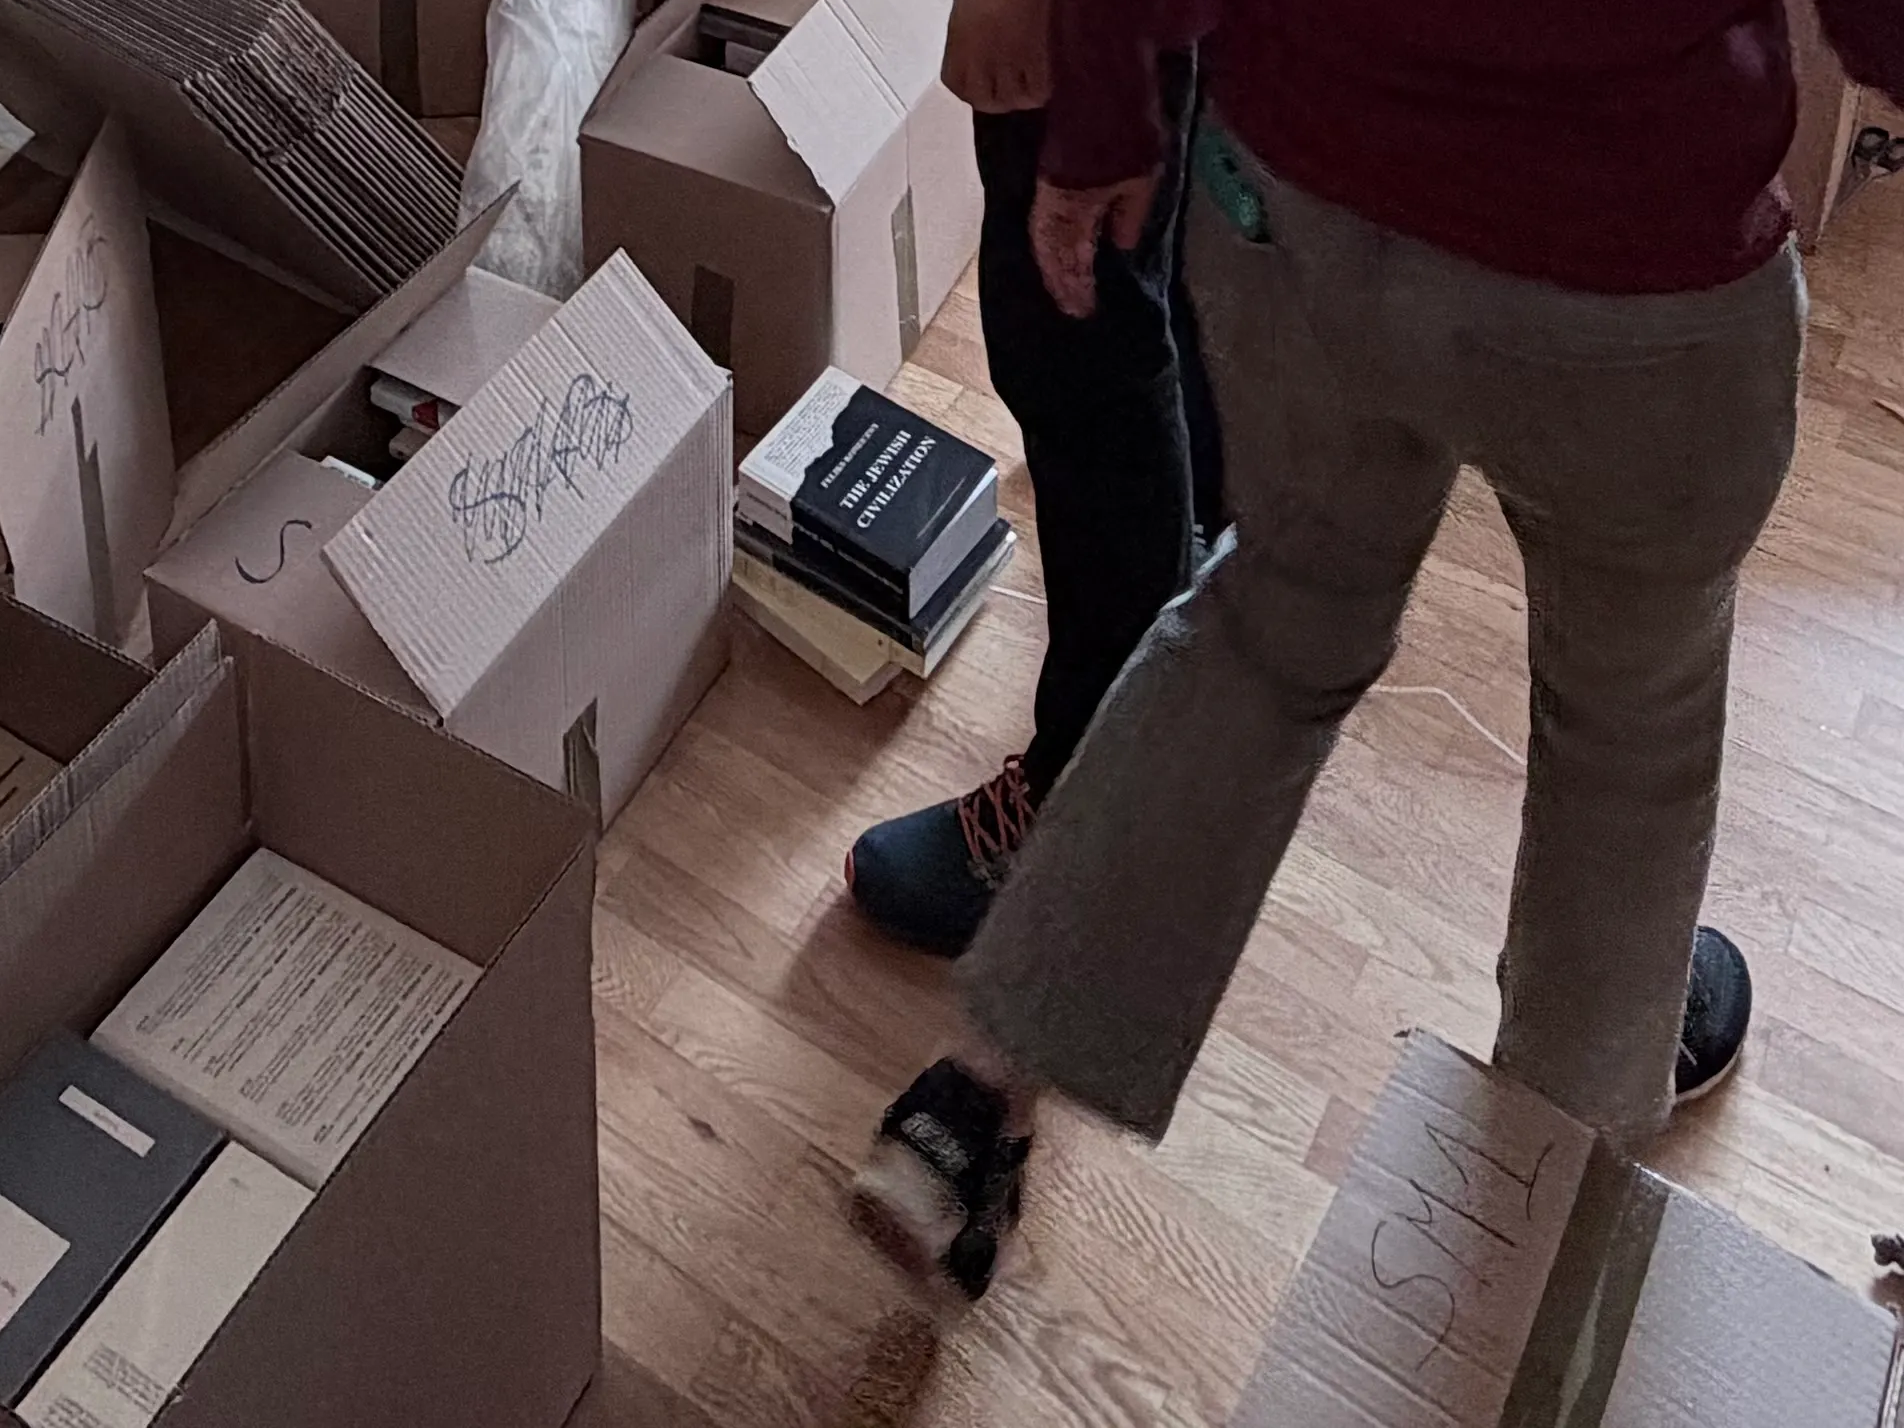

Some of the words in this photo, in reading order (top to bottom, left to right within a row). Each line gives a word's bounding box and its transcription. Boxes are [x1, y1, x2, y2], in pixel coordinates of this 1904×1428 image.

[839, 479, 871, 509] THE
[865, 430, 912, 483] JEWISH
[857, 435, 936, 528] CIVILIZATION
